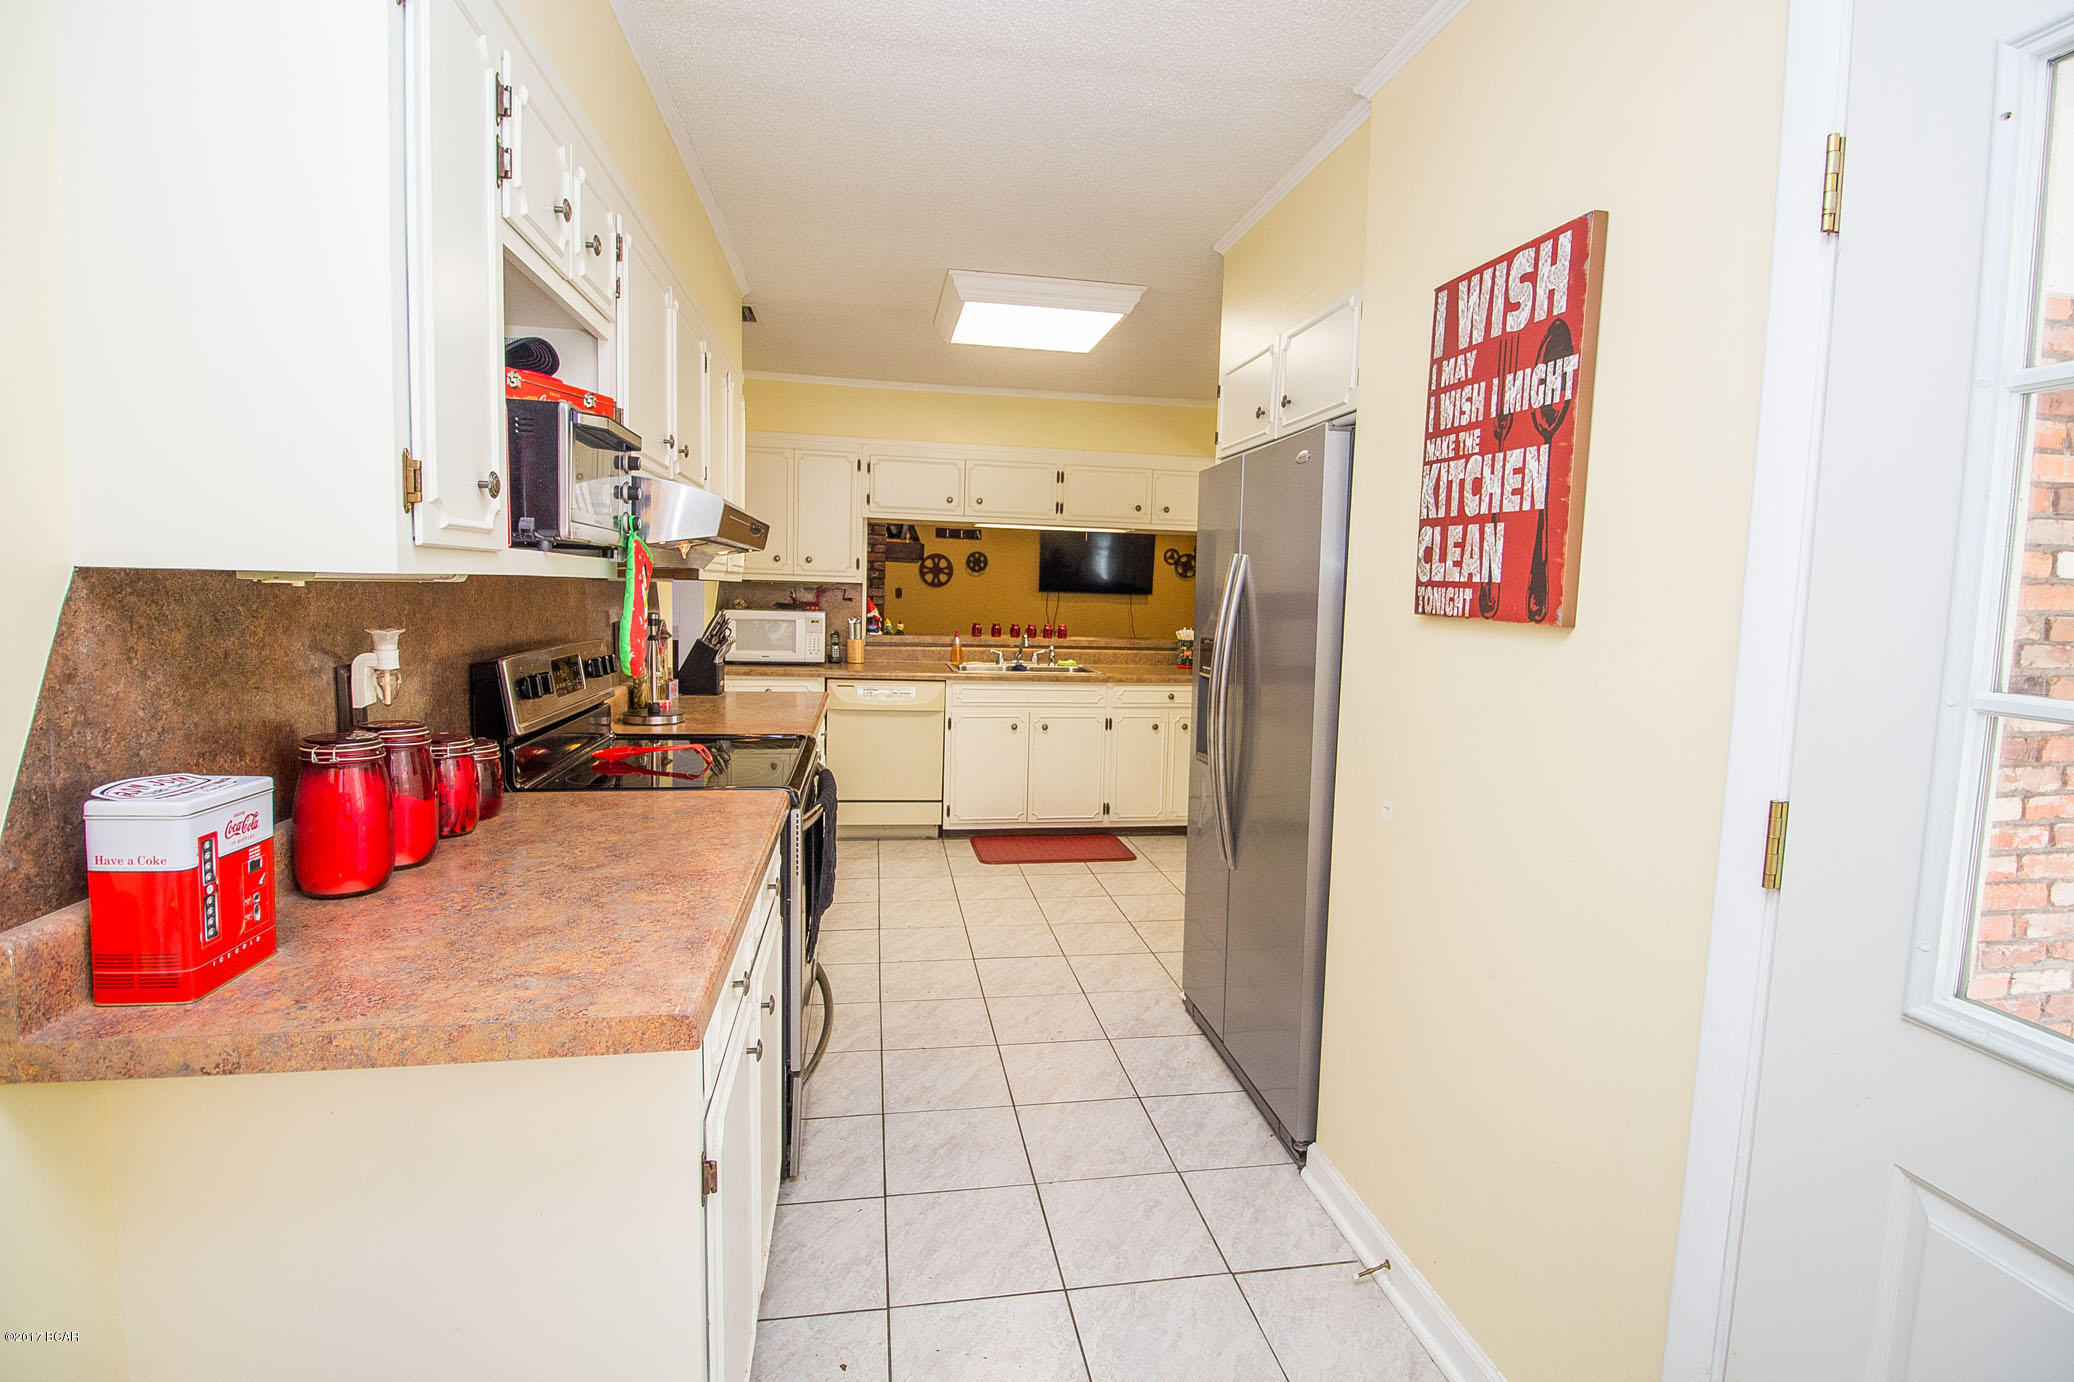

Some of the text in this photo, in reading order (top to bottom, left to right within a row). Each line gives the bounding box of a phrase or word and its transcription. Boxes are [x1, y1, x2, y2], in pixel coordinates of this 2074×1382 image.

[1433, 229, 1573, 360] I WISH
[1428, 353, 1580, 433] I WISH I MIGHT
[1431, 350, 1478, 391] I MAY
[1425, 428, 1482, 463] MAKE THE
[1420, 443, 1550, 520] KITCHEN
[1417, 522, 1505, 584] CLEAN
[1417, 586, 1473, 617] TONIGHT
[95, 855, 168, 866] Have a Coke
